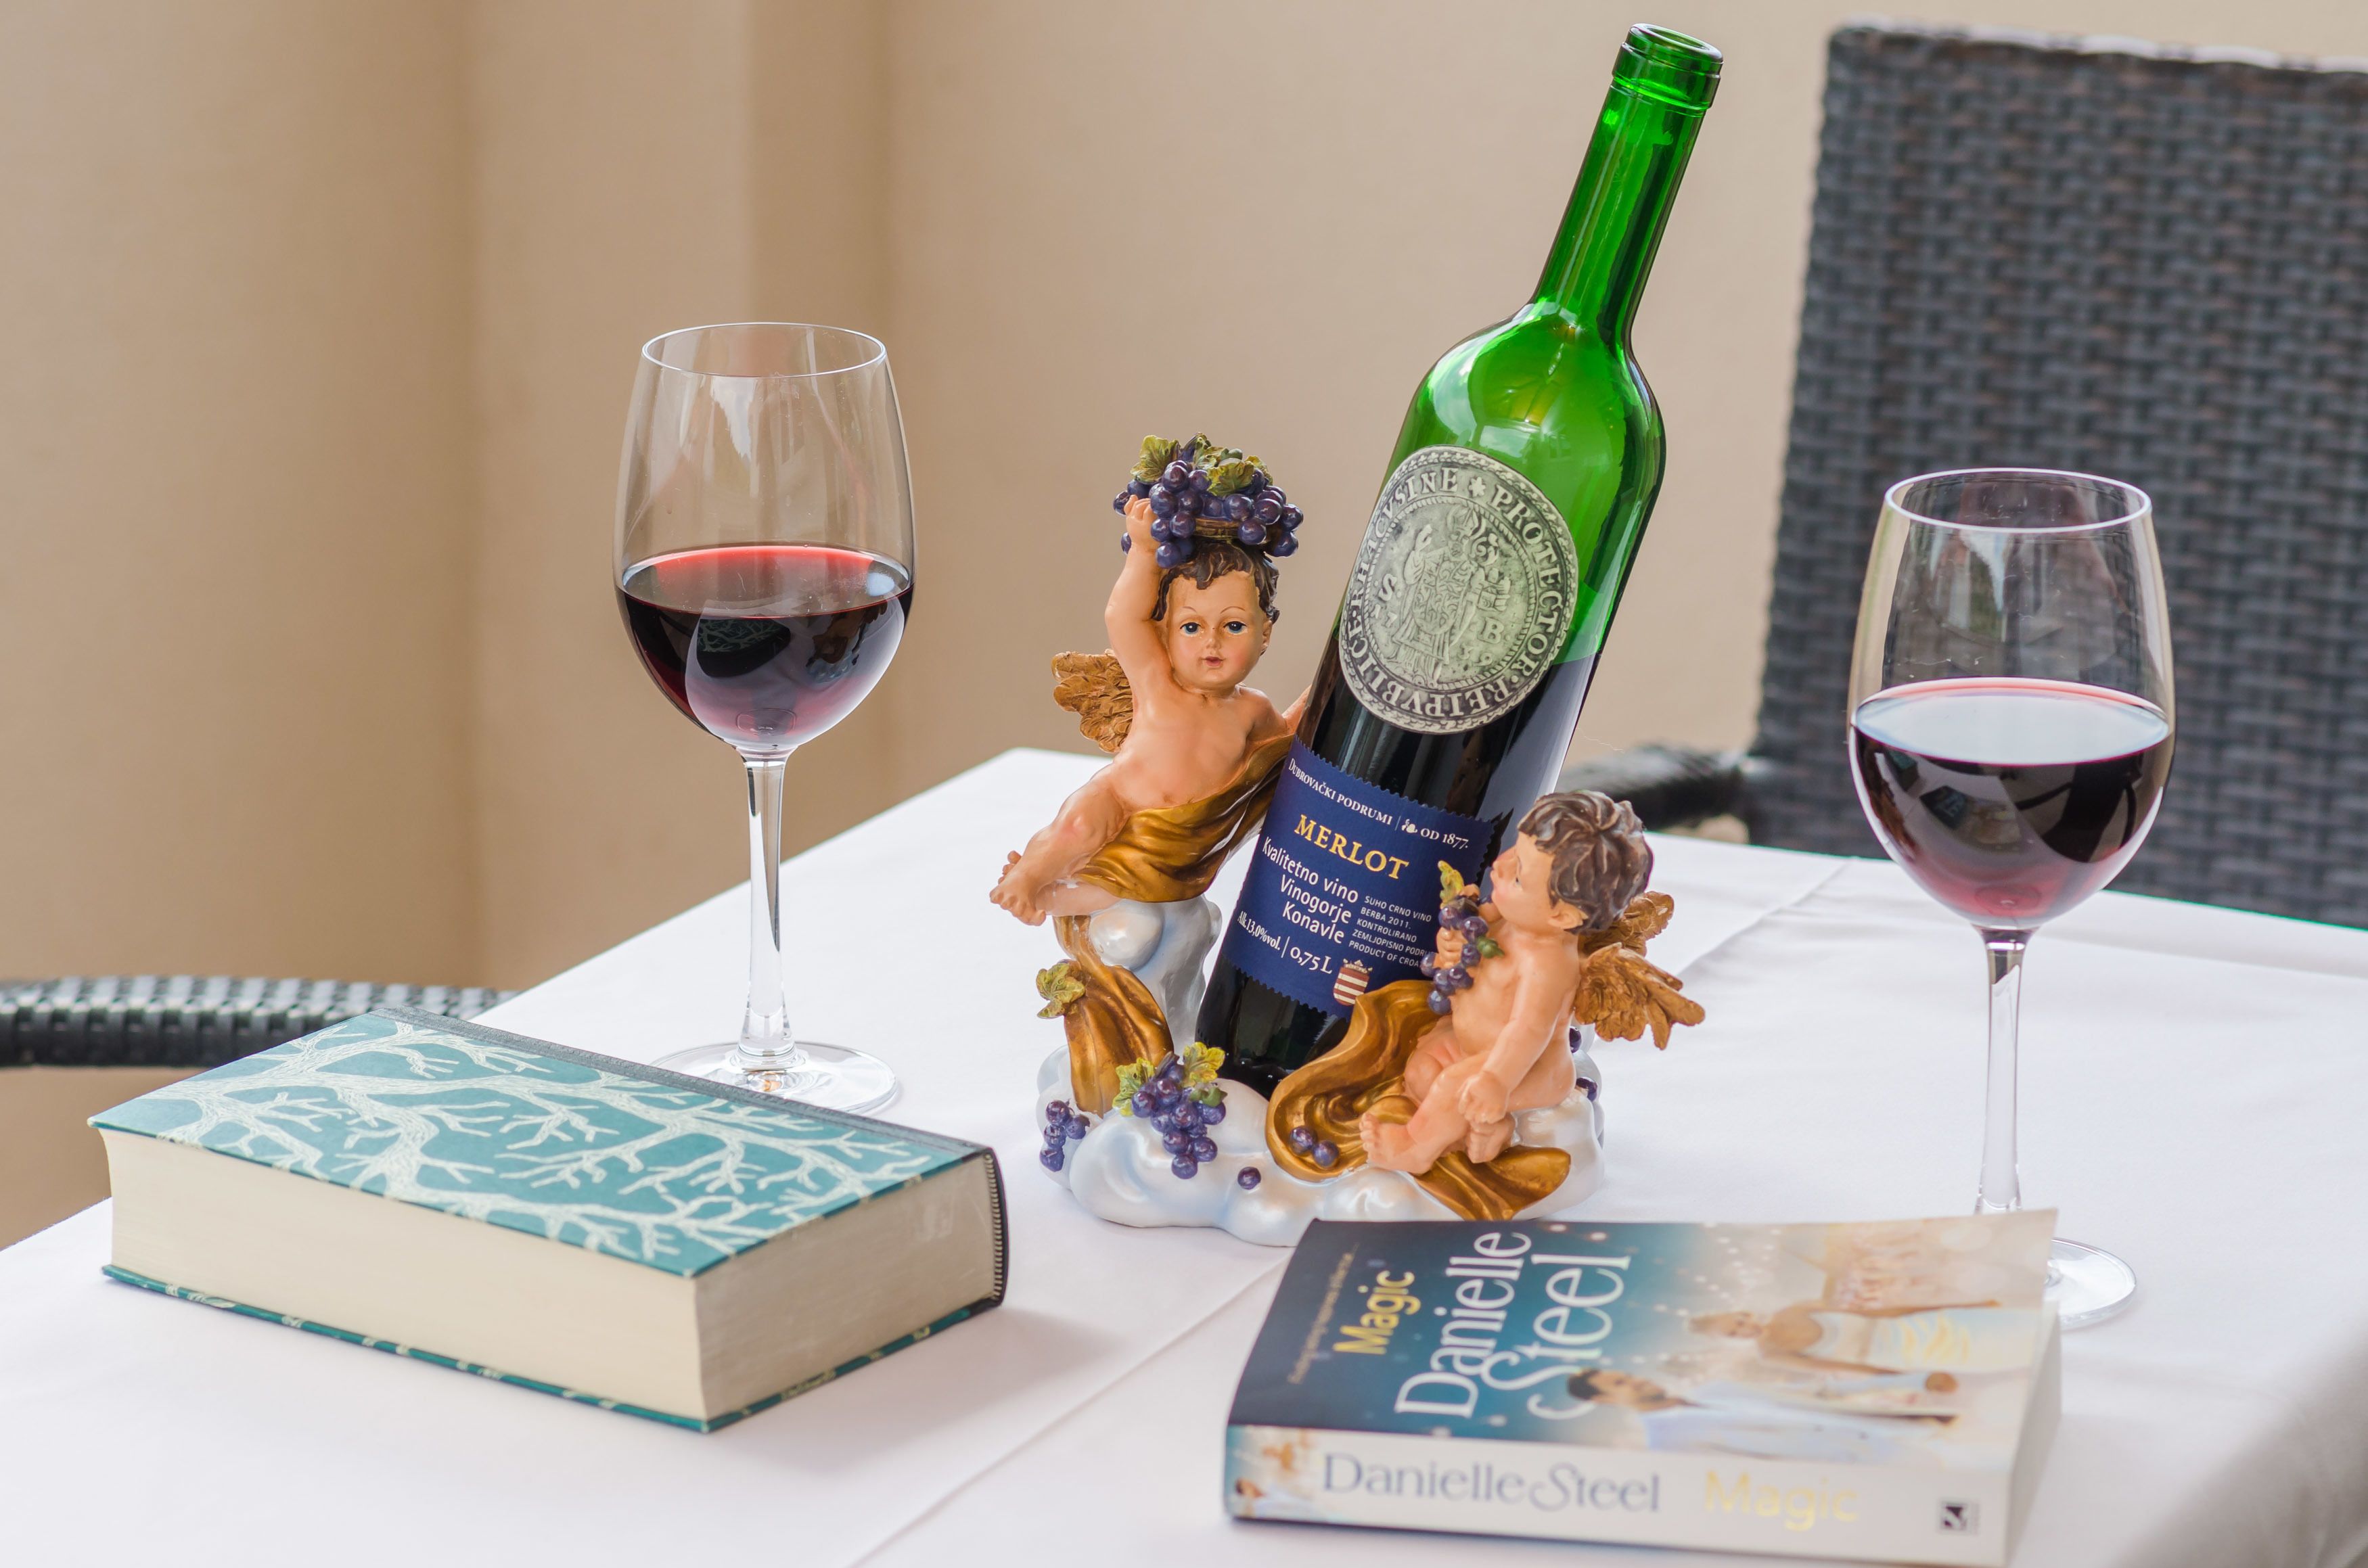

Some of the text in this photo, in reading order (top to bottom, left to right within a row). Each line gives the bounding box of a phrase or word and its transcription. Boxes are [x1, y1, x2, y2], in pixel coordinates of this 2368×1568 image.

[1488, 484, 1562, 676] PROTECTOR
[1478, 617, 1504, 644] B
[1288, 758, 1469, 850] DUBROVAČKI PODRUMI OD 1877.
[1262, 836, 1359, 903] Kvalitetno vino
[1294, 814, 1409, 879] MERLOT
[1281, 874, 1352, 923] Vinogorje
[1282, 901, 1344, 944] Konavle
[1361, 907, 1412, 929] BERBA 2011.
[1364, 896, 1432, 923] SUHO CRNO VINO
[1348, 940, 1421, 968] PRODUCT OF CROA
[1352, 929, 1428, 957] ZEMLJOPISNO PODR
[1357, 919, 1417, 943] KONTROLIRANO
[1331, 1270, 1421, 1355] Magic
[1394, 1231, 1532, 1419] Danielle
[1480, 1253, 1631, 1421] Steel
[1323, 1452, 1660, 1513] Danielle Steel
[1703, 1471, 1859, 1531] Magic
